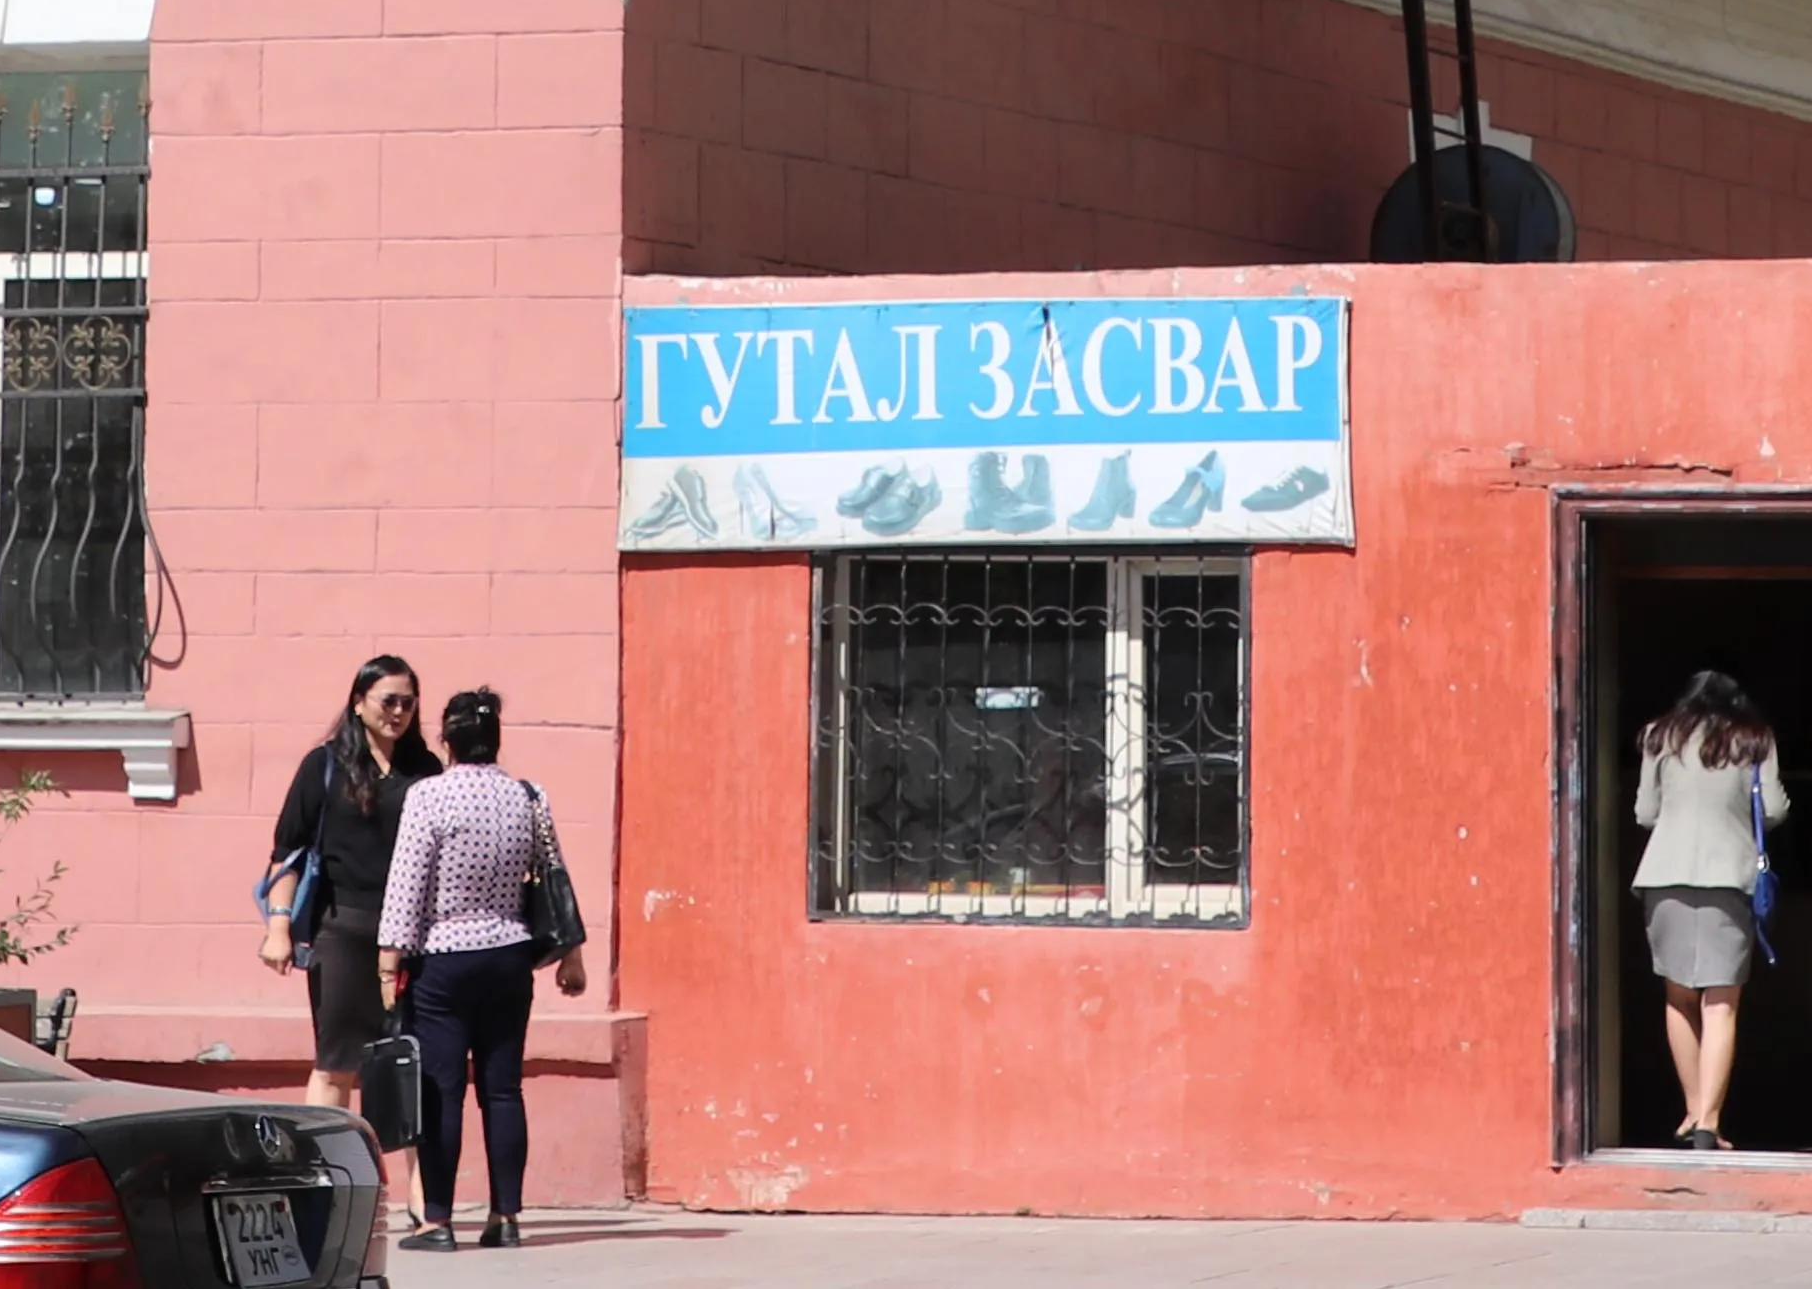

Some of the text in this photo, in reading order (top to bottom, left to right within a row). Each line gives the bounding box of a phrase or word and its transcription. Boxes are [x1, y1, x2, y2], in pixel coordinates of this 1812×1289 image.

[634, 313, 1323, 429] ГУТАЛ ЗАСВАР
[228, 1202, 285, 1243] 2224
[247, 1247, 280, 1276] УНГ
